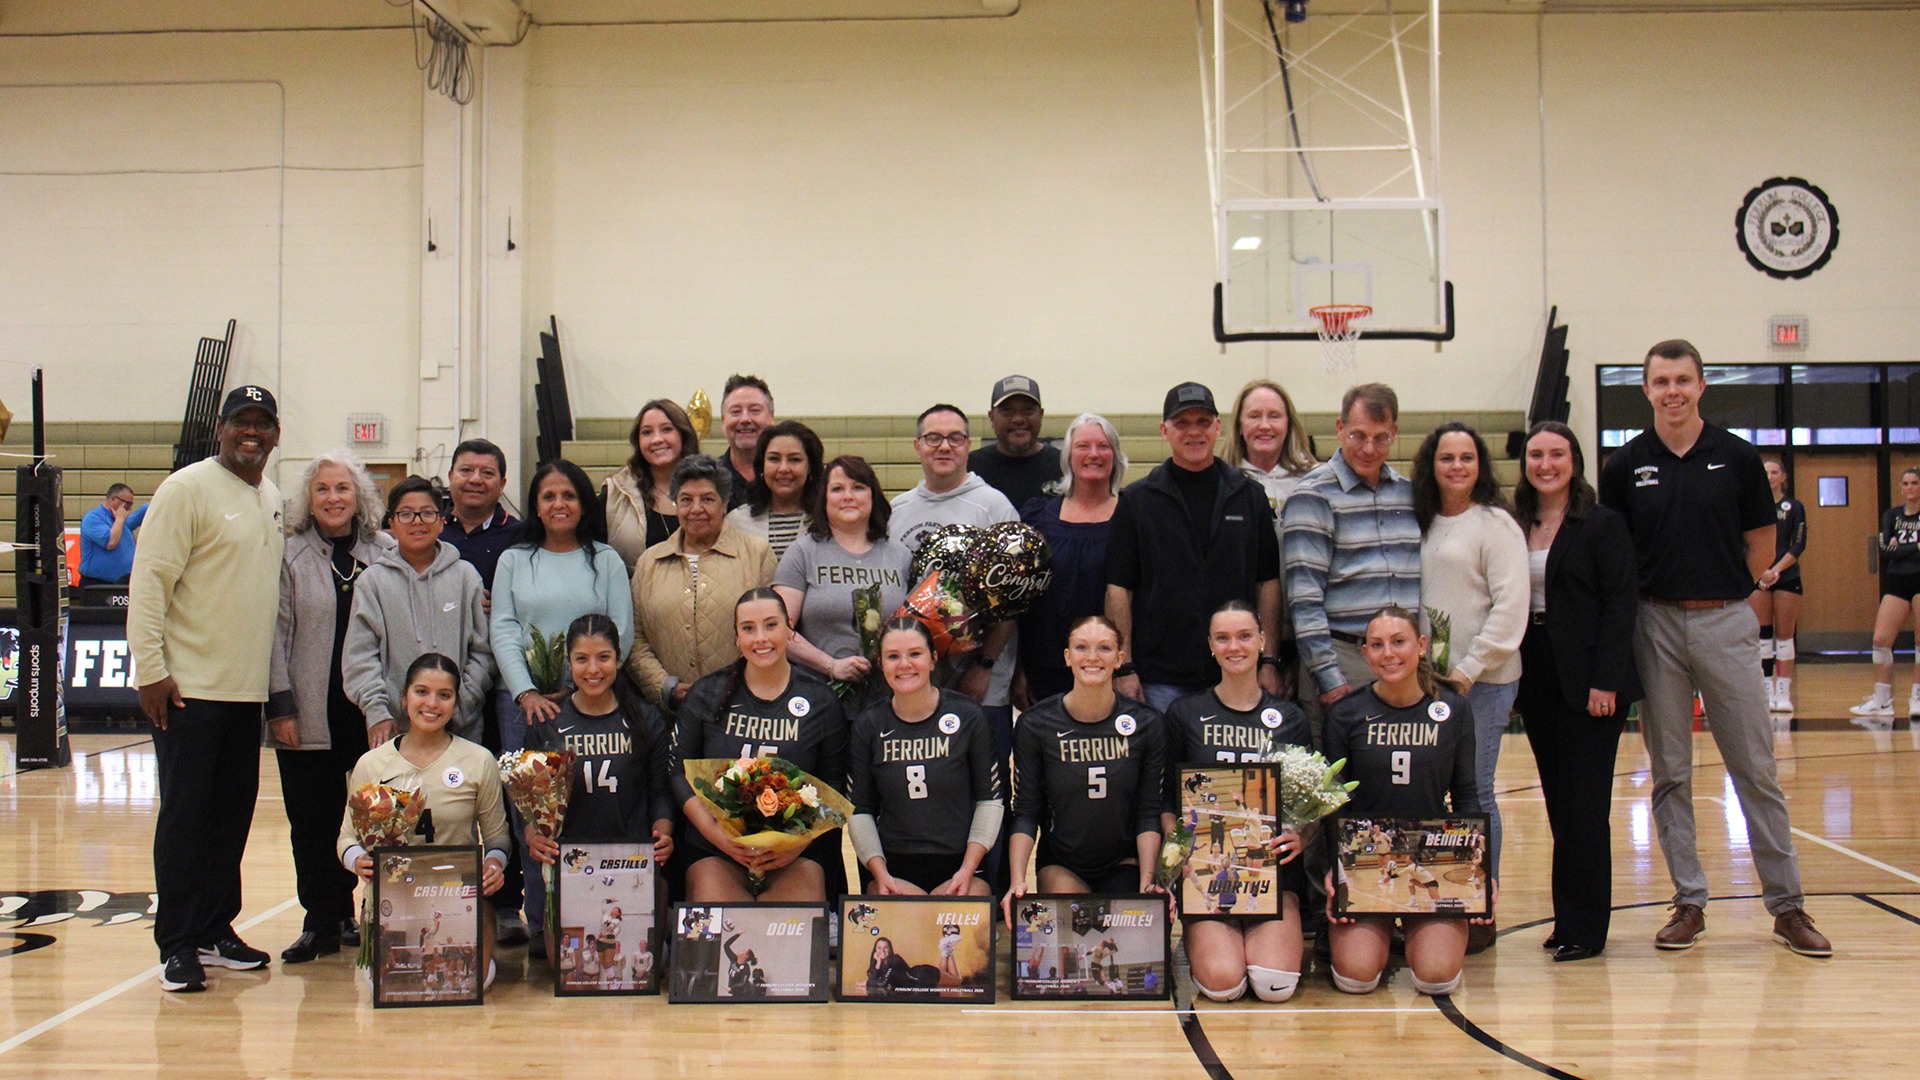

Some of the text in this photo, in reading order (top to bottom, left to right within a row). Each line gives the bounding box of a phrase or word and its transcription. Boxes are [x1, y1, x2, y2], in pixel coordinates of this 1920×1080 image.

[1777, 325, 1798, 341] EXIT
[246, 387, 262, 401] FC
[354, 423, 377, 439] EXIT
[817, 565, 901, 587] FERRUM
[29, 644, 41, 718] sports imports
[726, 712, 799, 741] FERRUM
[1204, 724, 1273, 748] FERRUM
[1367, 722, 1439, 746] FERRUM
[565, 732, 632, 756] FERRUM
[883, 736, 950, 762] FERRUM
[1059, 736, 1129, 762] FERRUM
[583, 759, 618, 794] 14
[1391, 750, 1411, 785] 9
[906, 764, 928, 799] 8
[1088, 766, 1107, 799] 5
[415, 808, 435, 843] 4
[1425, 833, 1478, 846] BENNETT
[600, 859, 649, 869] CASTILLO
[413, 885, 470, 897] CASTILLO
[1207, 880, 1270, 894] WORTHY
[936, 912, 980, 926] KELLEY
[1102, 914, 1153, 927] RUMLEY
